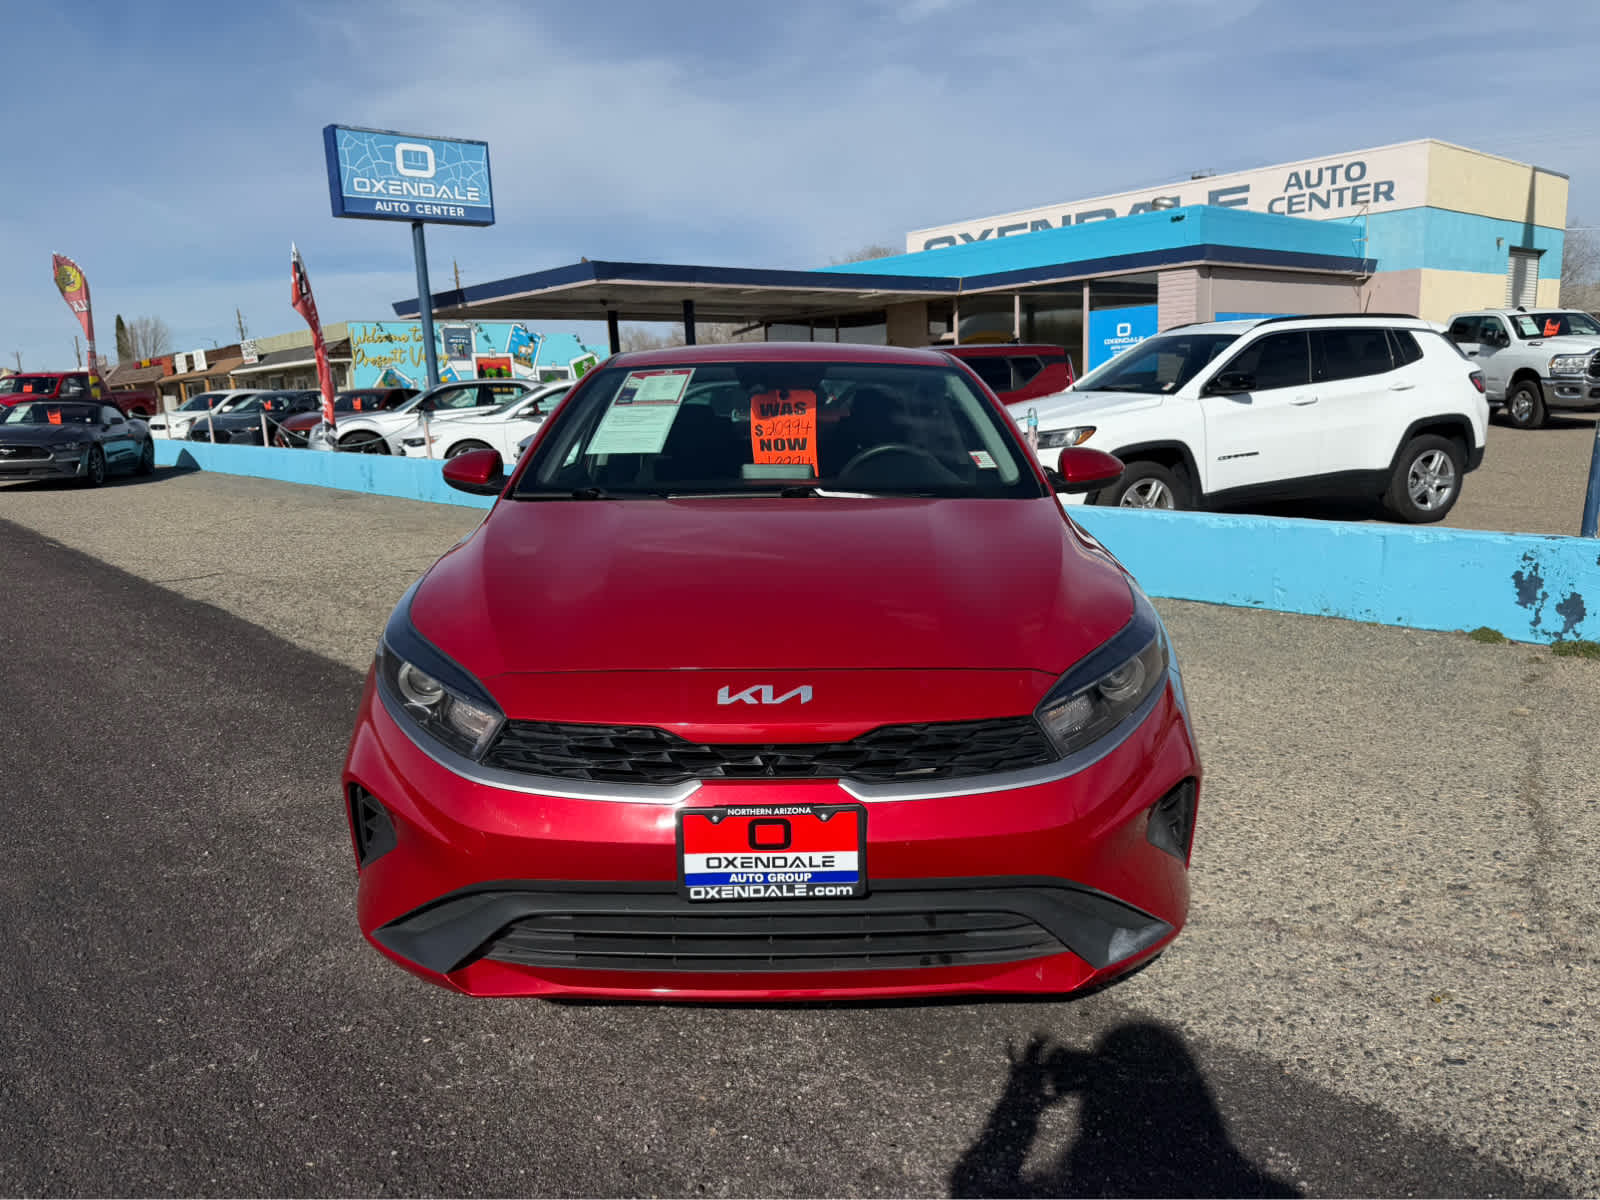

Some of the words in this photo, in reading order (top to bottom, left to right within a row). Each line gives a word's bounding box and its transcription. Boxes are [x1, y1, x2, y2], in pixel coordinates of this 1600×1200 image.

[1283, 160, 1368, 193] AUTO
[353, 176, 481, 202] OXENDALE
[1267, 180, 1396, 216] CENTER
[375, 200, 410, 214] AUTO
[415, 203, 466, 217] CENTER
[760, 402, 807, 417] WAS
[760, 437, 808, 452] NOW
[727, 807, 771, 816] NORTHERN
[774, 806, 812, 815] ARIZONA
[706, 855, 835, 869] OXENDALE
[729, 873, 764, 883] AUTO
[767, 872, 812, 882] GROUP
[690, 885, 853, 899] OXENDALE.com
